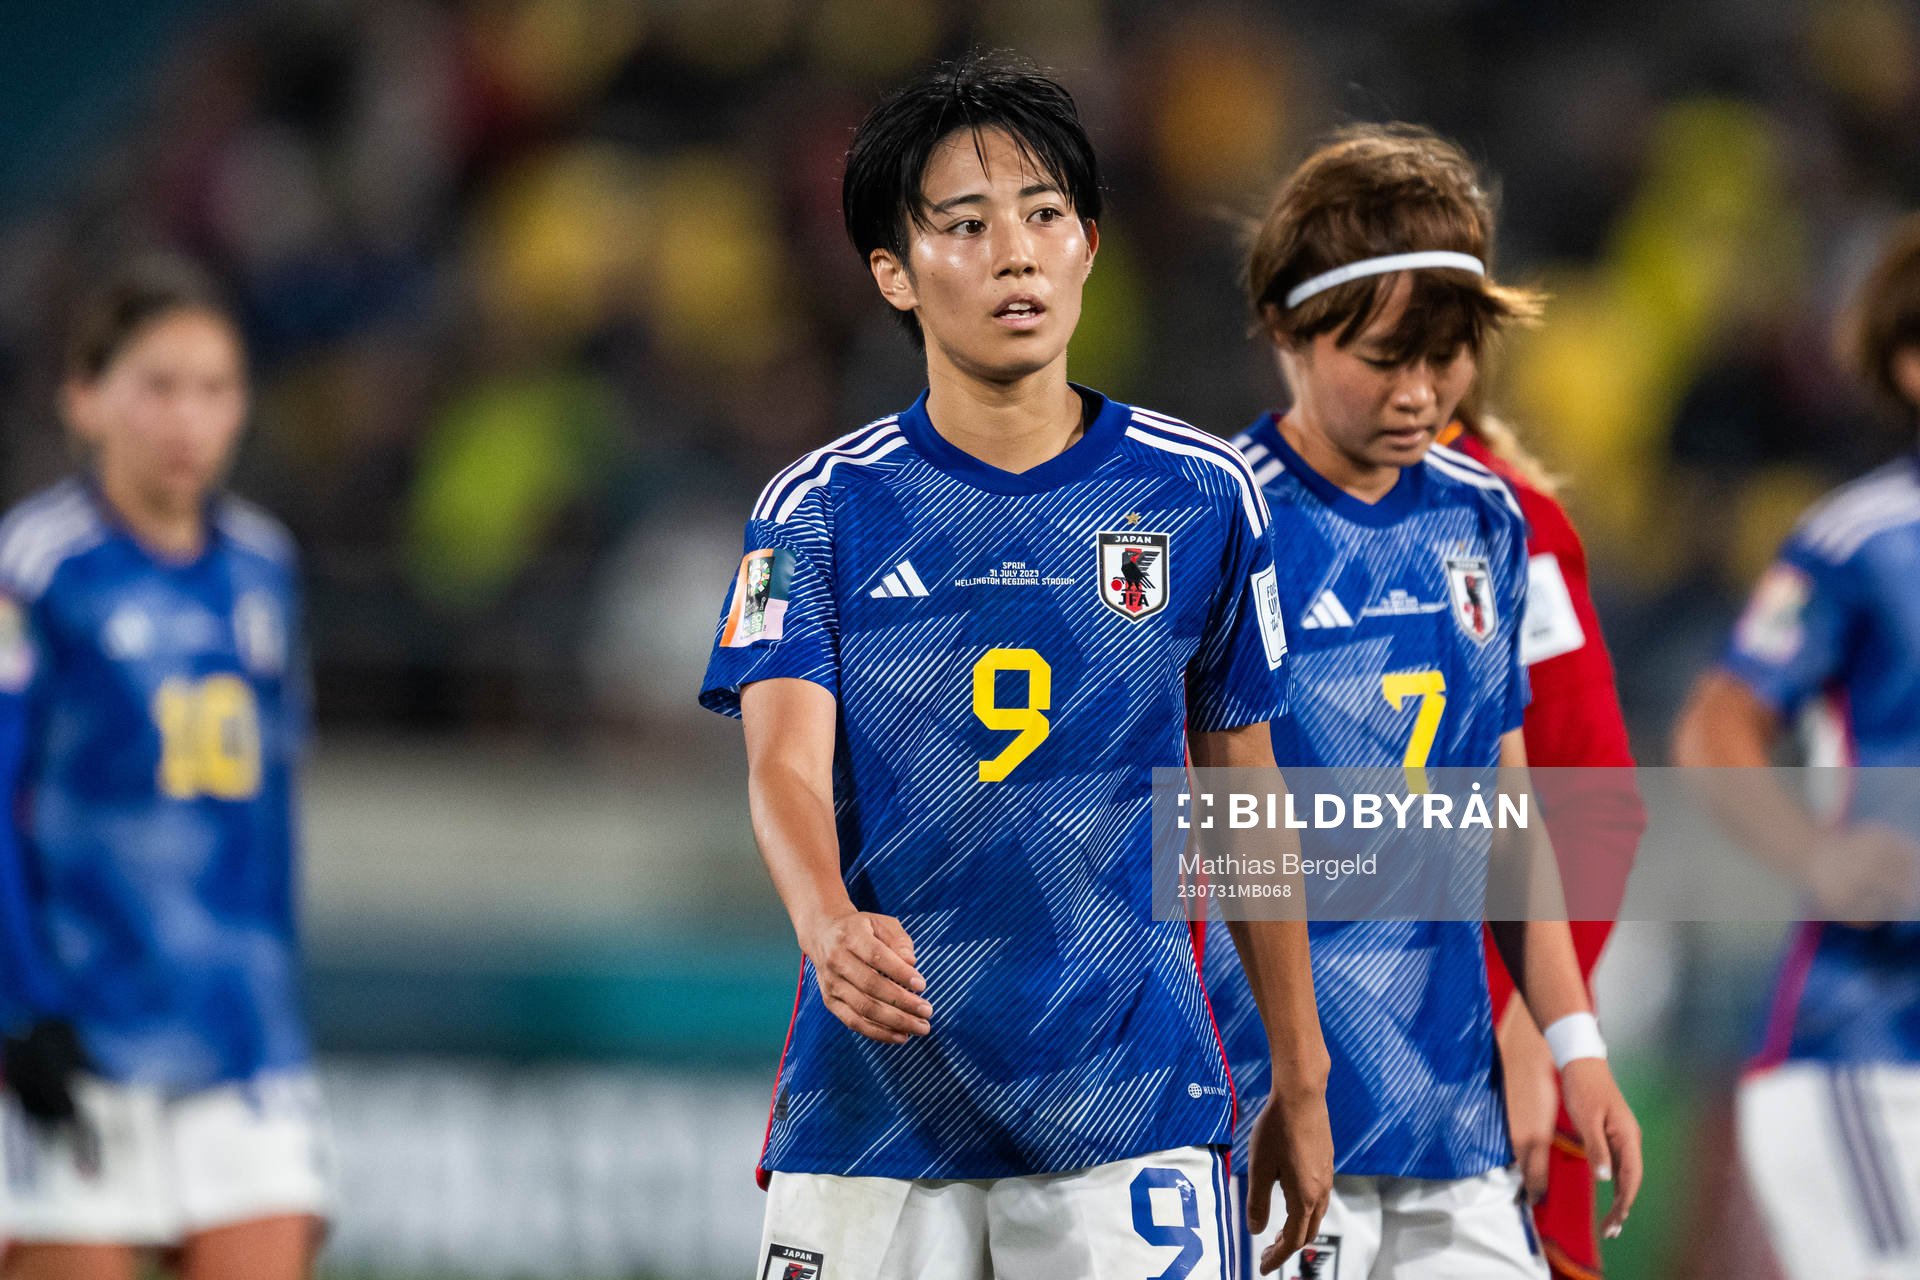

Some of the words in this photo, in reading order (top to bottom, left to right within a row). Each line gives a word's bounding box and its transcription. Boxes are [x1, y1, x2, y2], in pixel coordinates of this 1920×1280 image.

[1115, 535, 1151, 544] JAPAN
[1002, 561, 1026, 569] SPAIN
[989, 569, 998, 577] 31
[1000, 569, 1018, 577] JULY
[1019, 569, 1039, 577] 2023
[955, 577, 1000, 587] WELLINGTON
[1002, 578, 1040, 586] REGIONAL
[1041, 578, 1075, 586] STADIUM
[1118, 592, 1149, 607] JFA
[972, 648, 1051, 783] 9
[1382, 670, 1446, 795] 7
[782, 1248, 812, 1261] JAPAN
